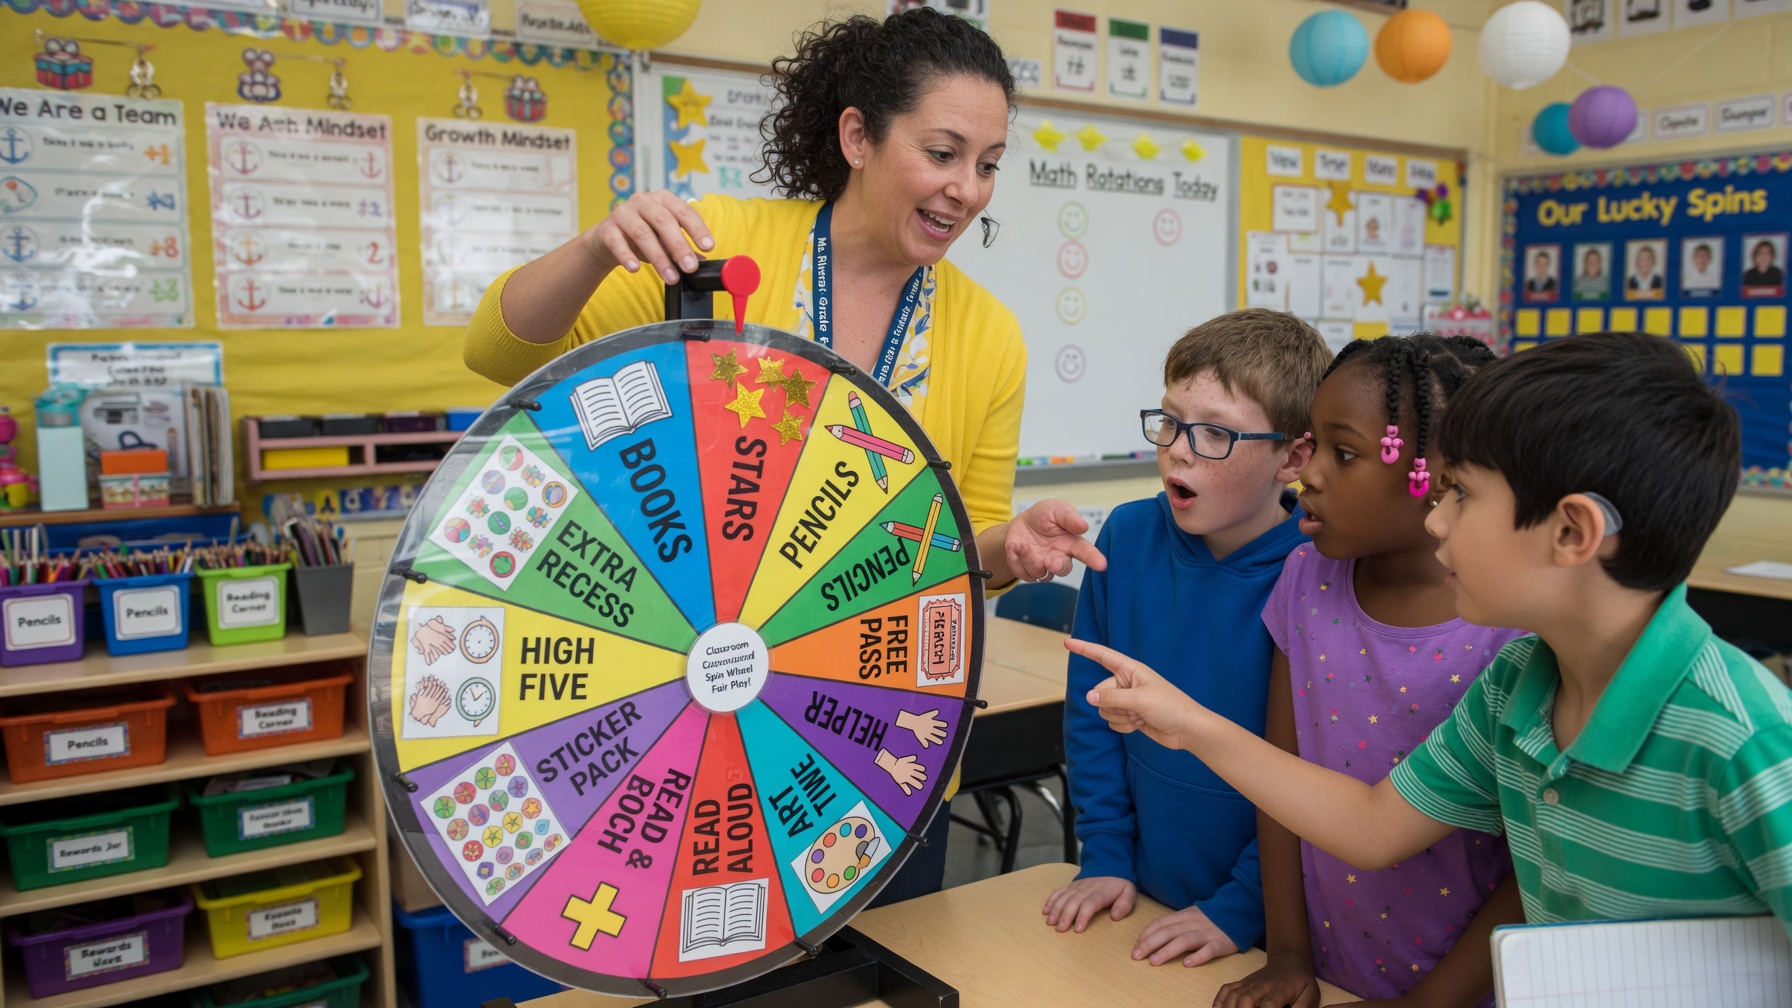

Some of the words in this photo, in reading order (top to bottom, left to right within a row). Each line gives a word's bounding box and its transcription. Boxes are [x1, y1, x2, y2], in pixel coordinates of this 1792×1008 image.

[37, 99, 83, 120] Are
[91, 106, 107, 121] a
[114, 104, 177, 127] Team
[216, 111, 250, 131] We
[306, 117, 386, 140] Mindset
[425, 124, 496, 146] Growth
[502, 130, 571, 151] Mindset
[1029, 159, 1077, 186] Math
[1172, 171, 1218, 203] Today
[1537, 199, 1590, 227] Our
[1597, 194, 1678, 227] Lucky
[1686, 184, 1768, 222] Spins
[619, 437, 693, 563] BOOKS
[721, 435, 768, 542] STARS
[779, 460, 860, 570] PENCILS
[555, 519, 638, 593] EXTRA
[820, 535, 911, 612] PENCILS
[125, 605, 169, 619] Pencils
[535, 548, 635, 628] RECESS
[18, 614, 62, 630] Pencils
[520, 636, 595, 665] HIGH
[859, 617, 882, 680] PASS
[886, 614, 909, 675] FREE
[254, 705, 298, 720] Reading
[520, 673, 589, 701] FIVE
[711, 683, 728, 694] Fair
[67, 736, 109, 751] Pencils
[536, 700, 643, 783] STICKER
[803, 690, 889, 752] HELPER
[569, 736, 640, 797] PACK
[596, 773, 656, 855] BOCH
[640, 767, 692, 844] READ
[727, 782, 754, 874] ALOUD
[767, 784, 815, 838] ART
[625, 848, 654, 869] &
[692, 798, 721, 876] READ
